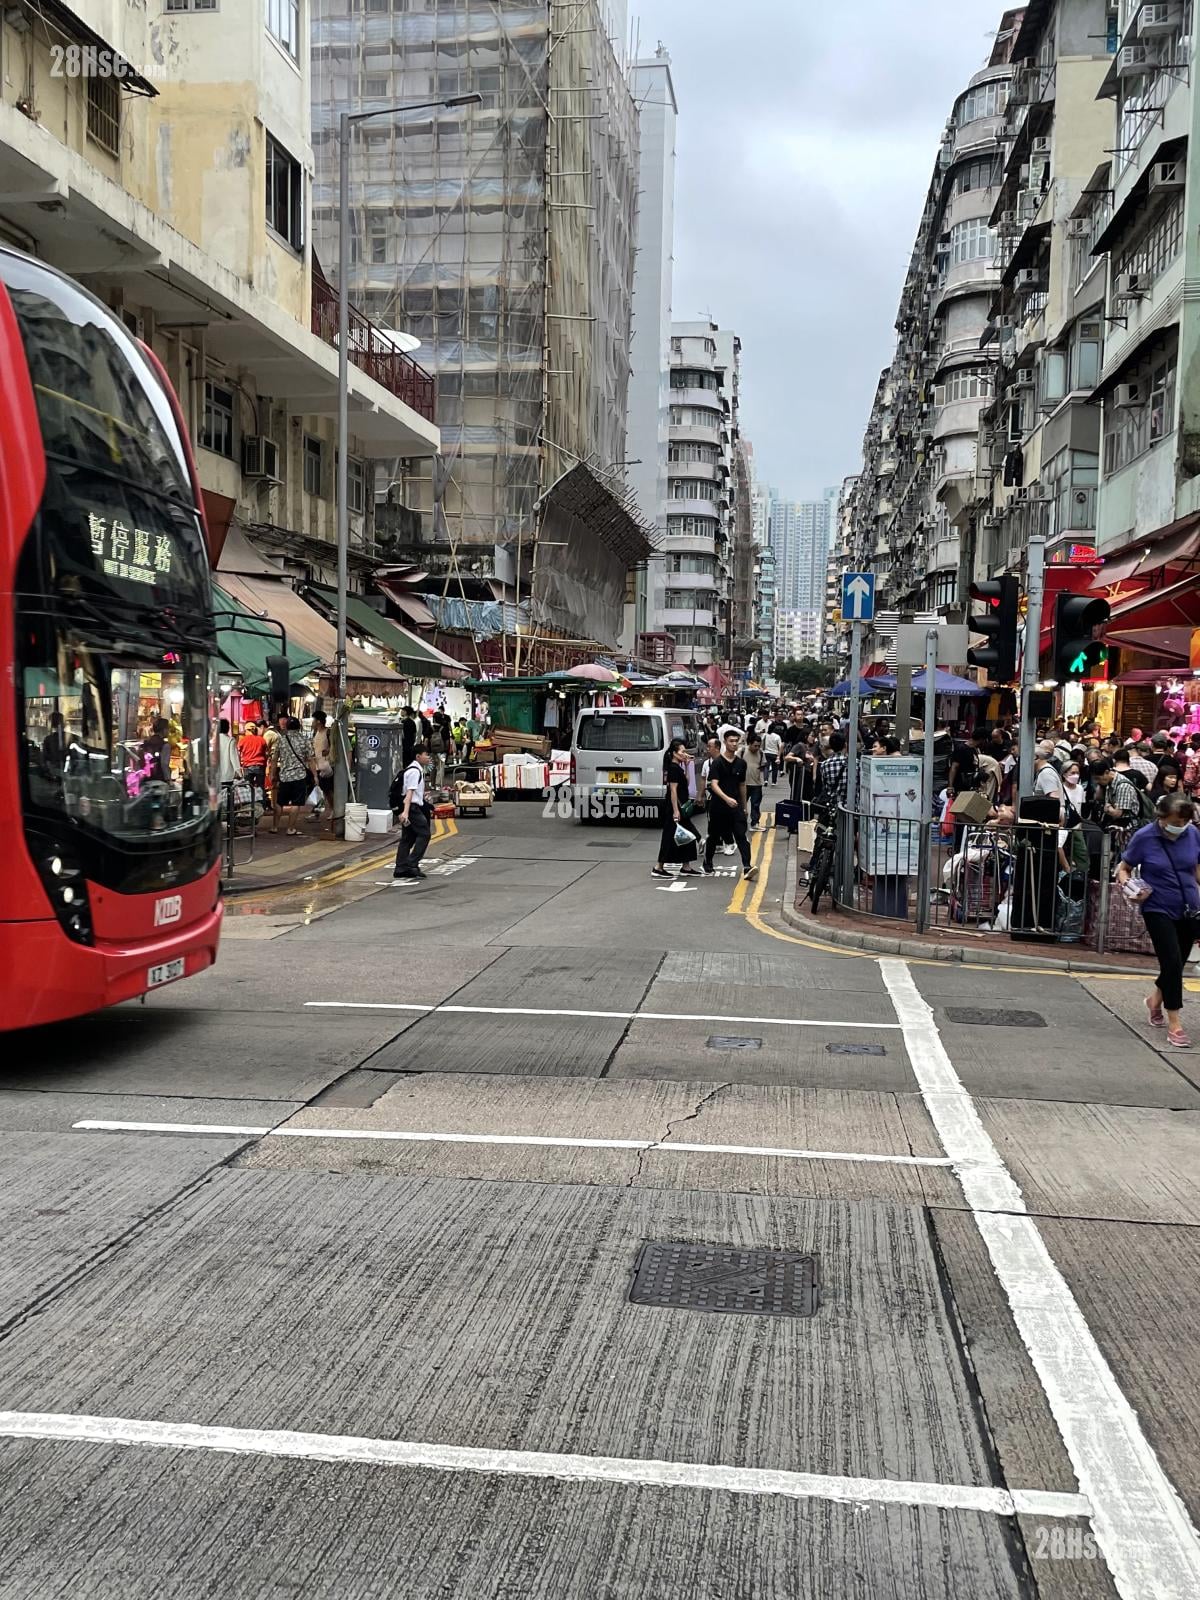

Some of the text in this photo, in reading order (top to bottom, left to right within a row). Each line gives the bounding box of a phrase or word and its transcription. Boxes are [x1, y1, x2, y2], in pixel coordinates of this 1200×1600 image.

[88, 512, 171, 572] 暫停服務
[154, 895, 182, 926] KMB
